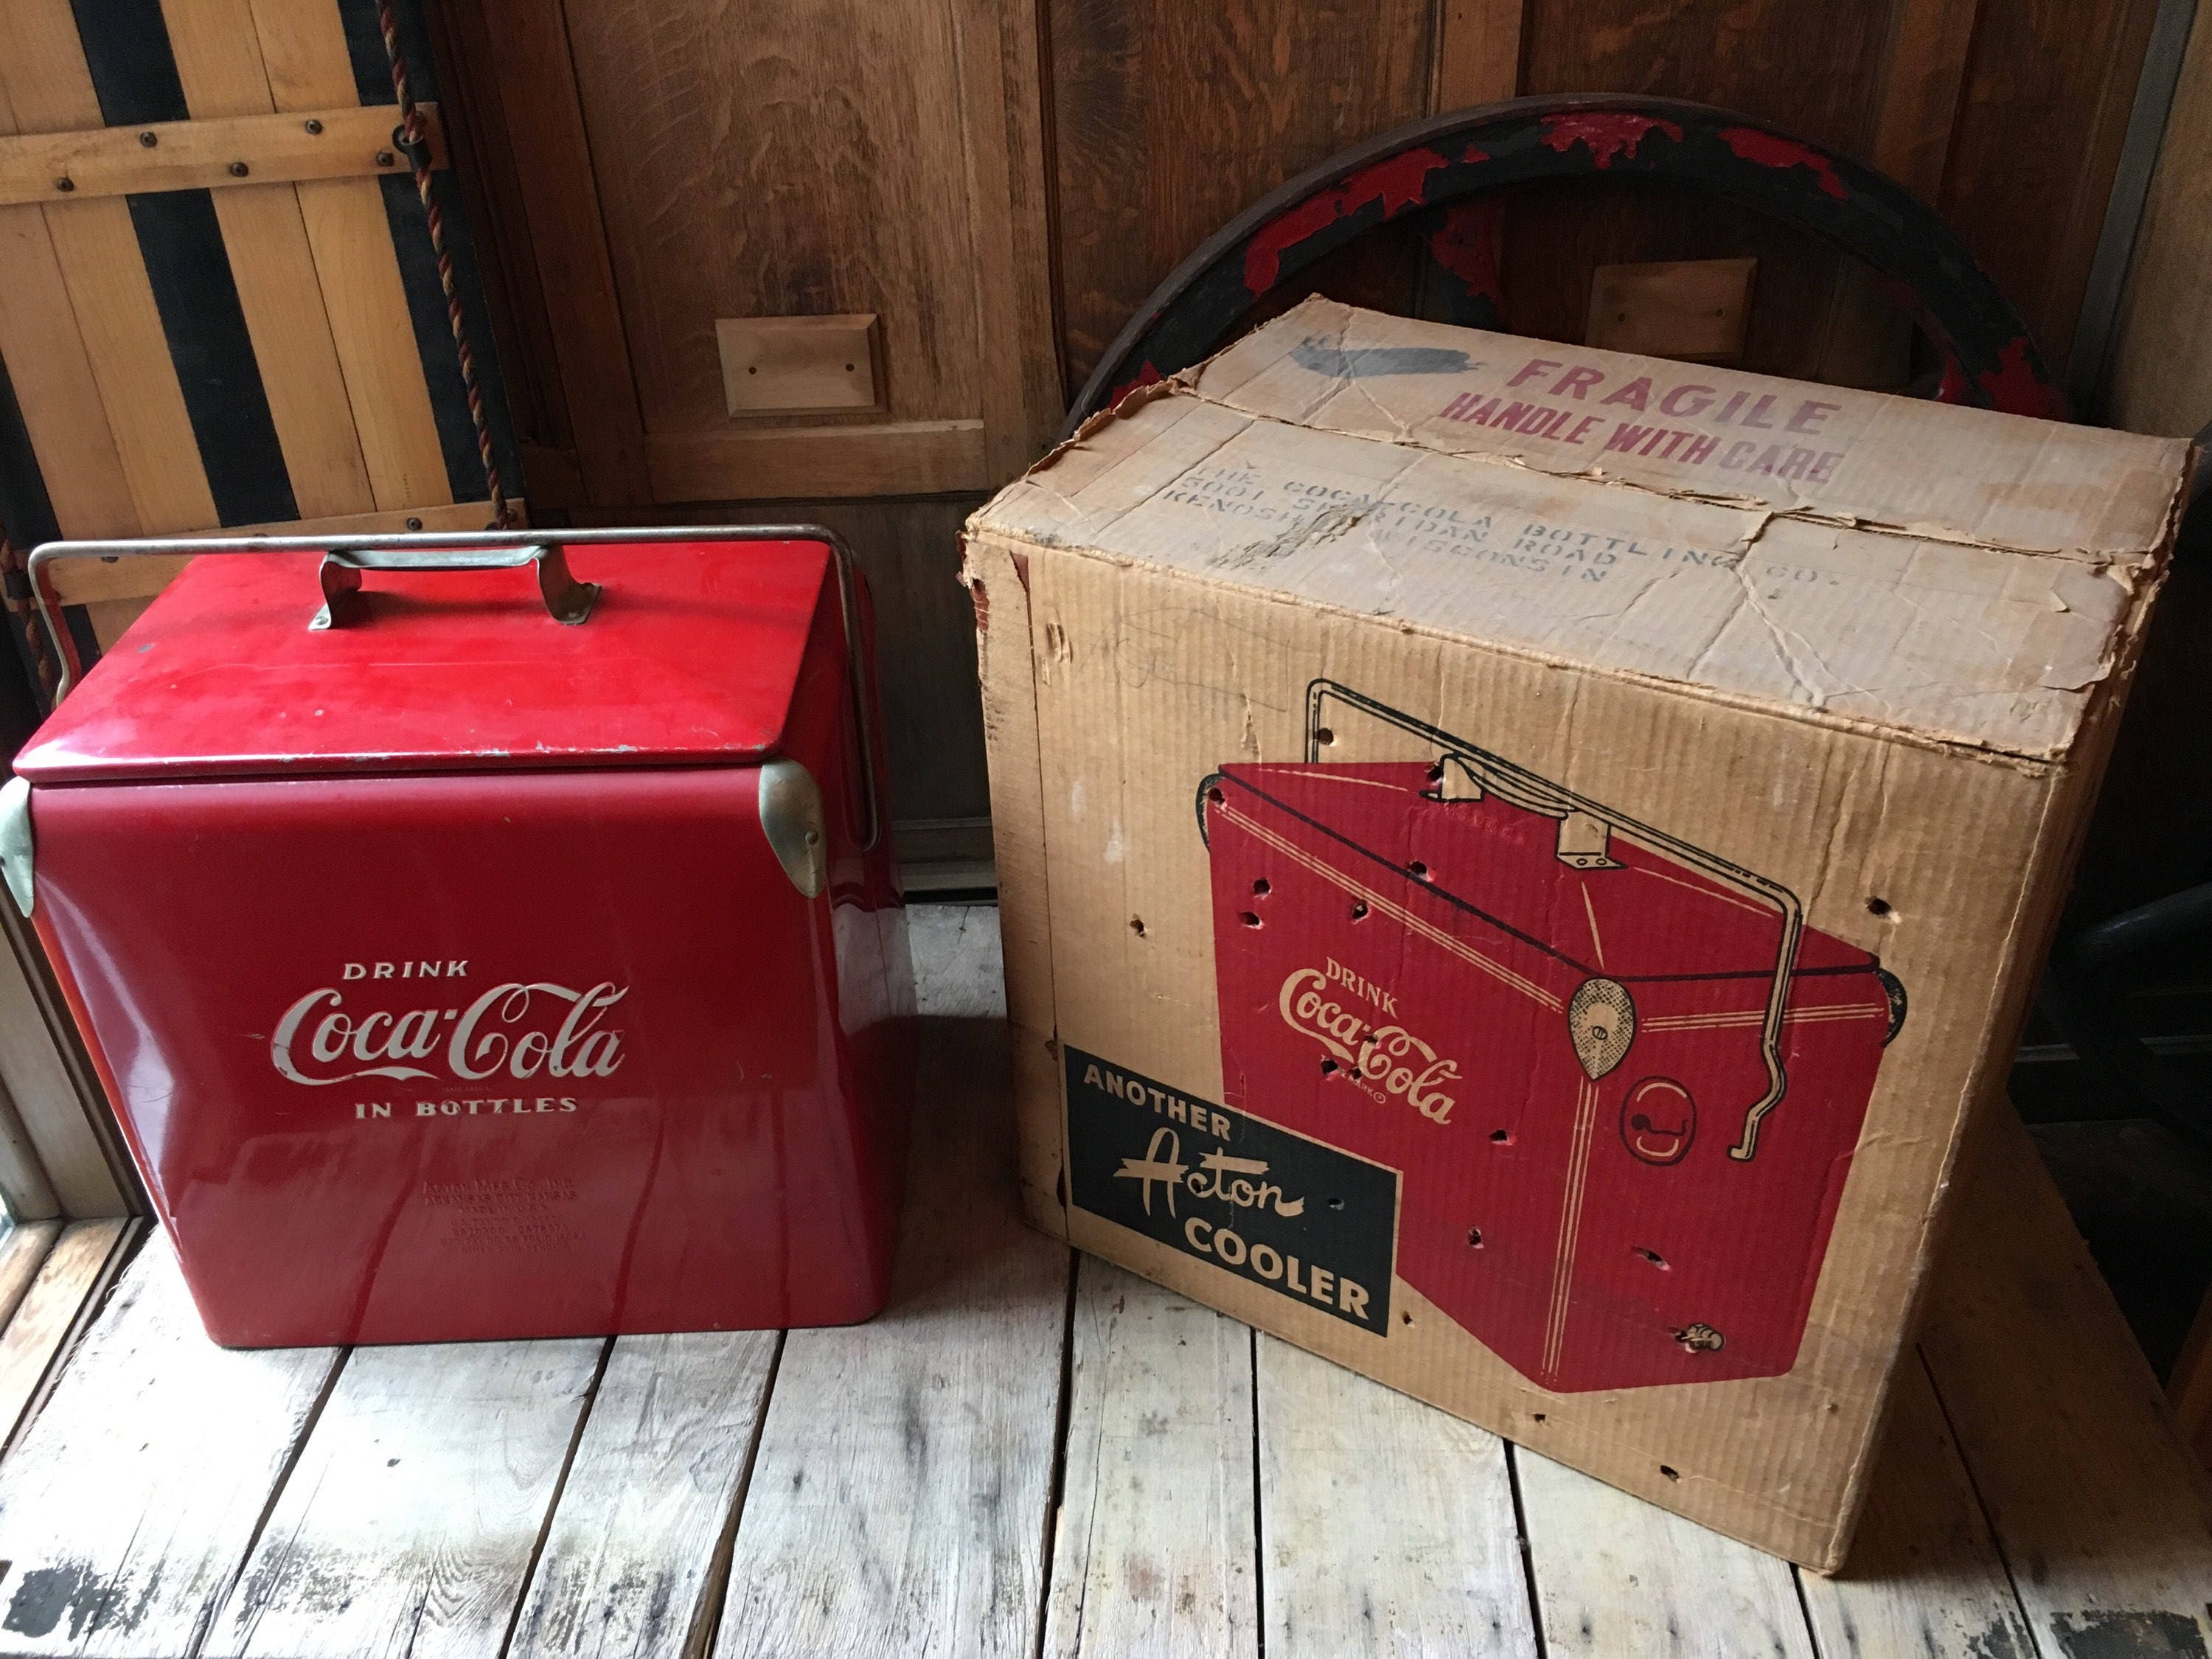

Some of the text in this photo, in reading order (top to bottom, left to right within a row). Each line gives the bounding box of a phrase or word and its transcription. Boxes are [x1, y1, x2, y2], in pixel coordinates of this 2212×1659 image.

[1439, 392, 1845, 484] HANDLE WITH CARE
[1506, 358, 1843, 435] FRAGILE
[1163, 490, 1607, 582] KENOSH WISCONSIN
[1197, 466, 1840, 586] THE COCA-COLA BOTTLING CO.
[1292, 498, 1489, 543] SHRIDAN
[1513, 538, 1616, 565] ROAD
[344, 960, 469, 981] DRINK
[1326, 956, 1399, 1020] DRINK
[270, 981, 630, 1086] Coca-Cola
[1279, 967, 1464, 1125] Coca-Cola
[355, 1097, 578, 1119] IN BOTTLES
[1083, 1063, 1231, 1142] ANOTHER
[1113, 1127, 1305, 1220] Acton
[1184, 1216, 1370, 1321] COOLER
